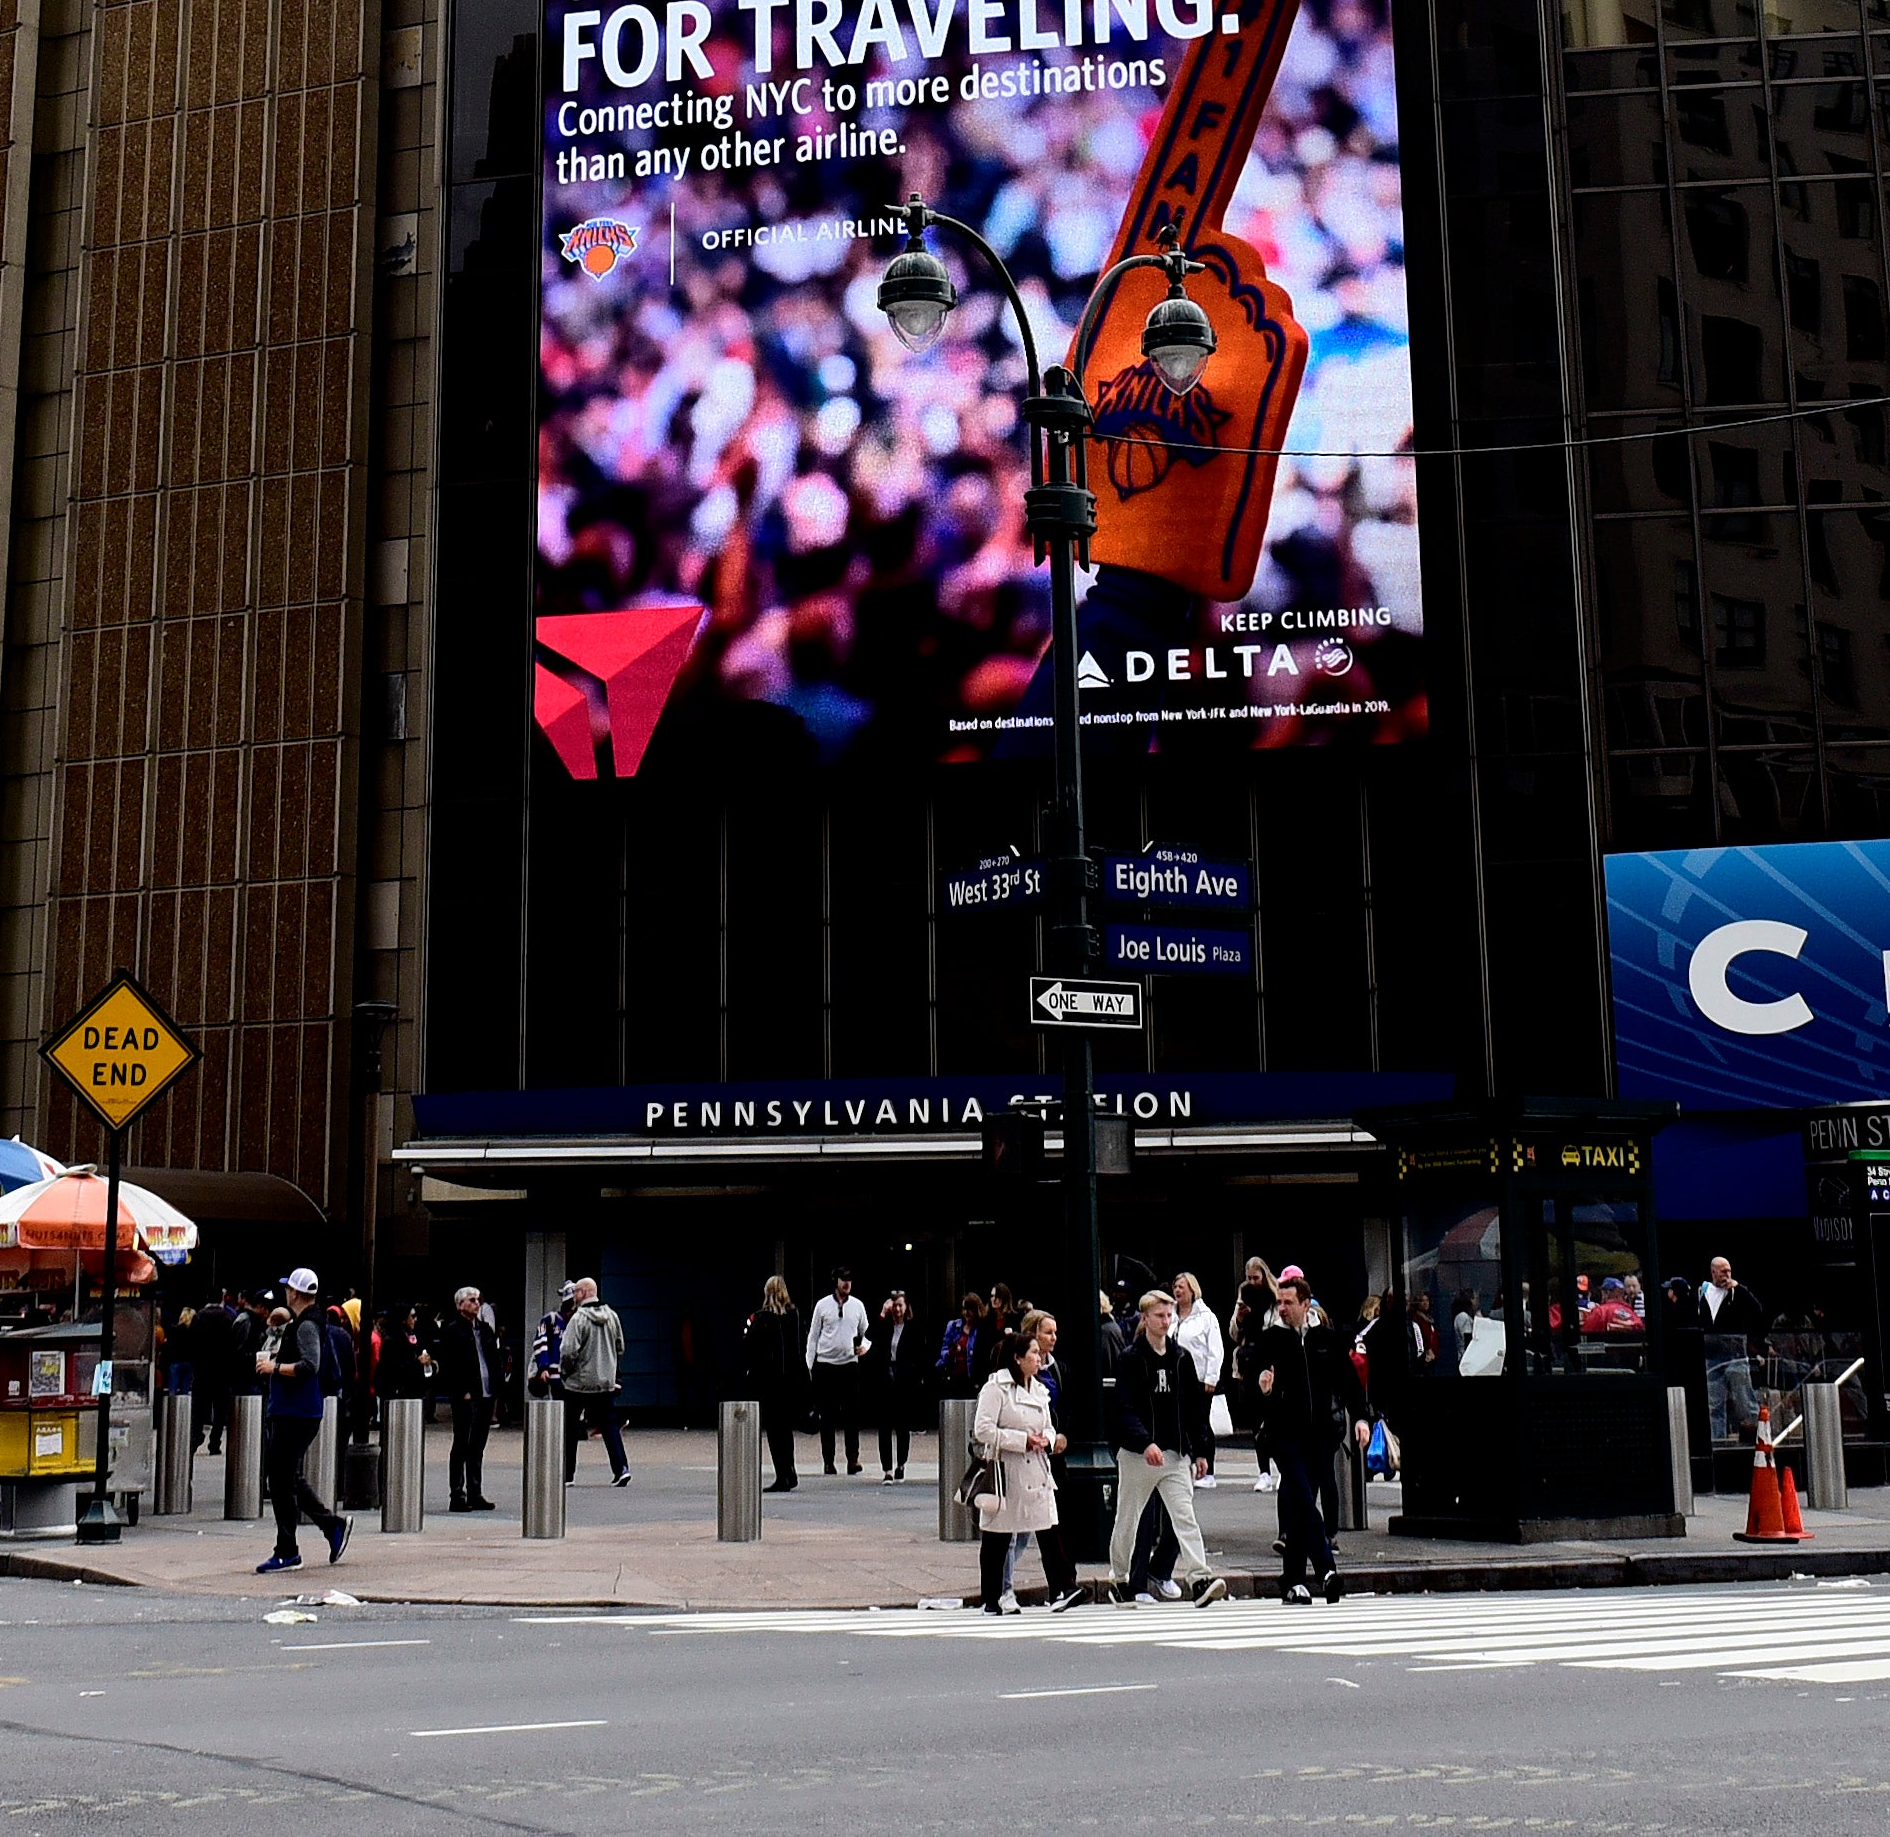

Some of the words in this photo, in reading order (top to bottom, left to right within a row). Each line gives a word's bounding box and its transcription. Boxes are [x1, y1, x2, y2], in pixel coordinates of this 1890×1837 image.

[557, 90, 734, 138] Connecting
[745, 79, 813, 119] NYC
[821, 78, 856, 112] to
[867, 75, 950, 108] more
[961, 56, 1167, 101] destinations
[555, 149, 625, 185] than
[635, 146, 691, 182] any
[701, 134, 787, 170] other
[796, 123, 907, 160] airline.
[570, 224, 634, 252] KNICKS
[701, 224, 808, 251] OFFICIAL
[816, 217, 908, 240] AIRLINE
[1221, 612, 1273, 633] KEEP
[1281, 607, 1393, 630] CLIMBING
[1126, 643, 1300, 682] DELTA
[949, 718, 978, 731] Based
[980, 719, 993, 730] on
[995, 715, 1054, 729] destinations
[1093, 712, 1133, 725] nonstop
[1136, 711, 1159, 722] from
[1161, 710, 1183, 721] New
[1185, 708, 1227, 720] York-JFK
[1229, 706, 1248, 718] and
[1250, 706, 1273, 718] New
[1273, 702, 1350, 717] York-LaGuardia
[1352, 702, 1362, 713] in
[1364, 701, 1391, 713] 2019.
[1156, 851, 1172, 862] 458
[1181, 852, 1198, 863] 420
[949, 882, 988, 907] West
[992, 869, 1020, 900] 33rd
[1024, 869, 1040, 894] St
[1115, 864, 1187, 898] Eighth
[1196, 869, 1238, 897] Ave
[1118, 935, 1150, 960] Joe
[1156, 936, 1207, 963] Louis
[1213, 946, 1241, 962] Plaza
[1688, 919, 1814, 1035] C
[1048, 993, 1078, 1010] ONE
[1093, 995, 1125, 1012] WAY
[84, 1027, 159, 1050] DEAD
[93, 1062, 147, 1086] END
[646, 1096, 983, 1128] PENNSYLVANIA
[1810, 1117, 1859, 1150] PENN
[1581, 1146, 1625, 1167] TAXI
[1867, 1166, 1877, 1176] 34
[1867, 1177, 1887, 1187] Penn
[1871, 1190, 1879, 1201] A
[1882, 1190, 1890, 1201] C
